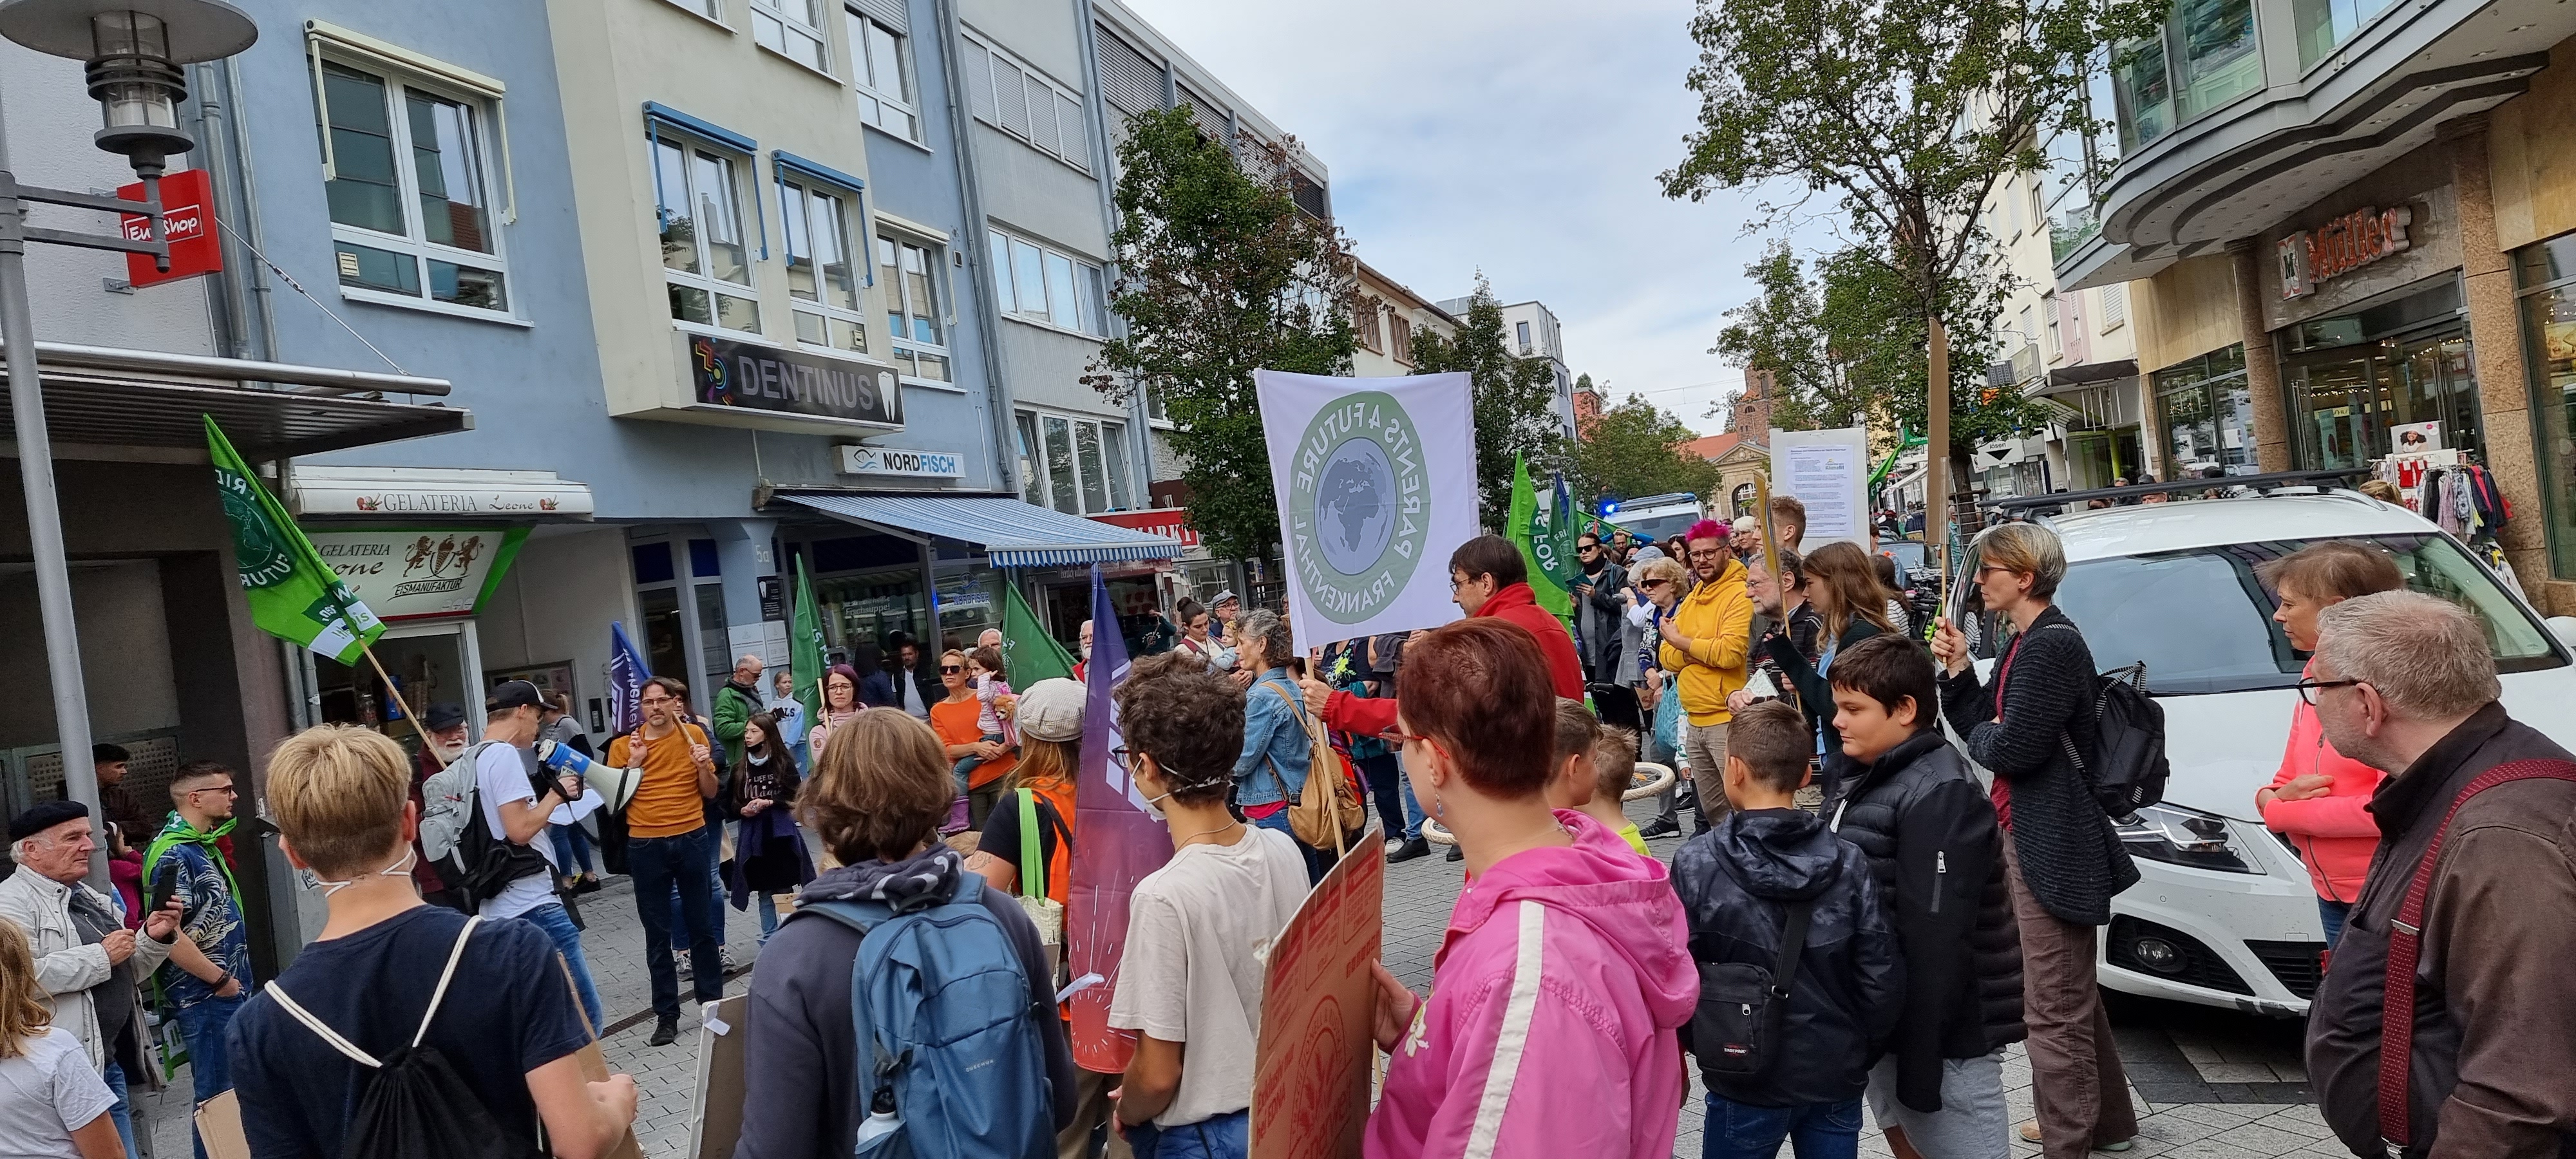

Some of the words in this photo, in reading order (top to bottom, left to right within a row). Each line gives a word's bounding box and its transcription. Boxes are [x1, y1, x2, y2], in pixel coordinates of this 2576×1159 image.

[2305, 207, 2398, 284] Müller
[737, 355, 875, 411] DENTINUS
[883, 451, 957, 473] NORDFISCH
[383, 493, 478, 512] GELATERIA
[488, 494, 535, 511] Leone
[320, 544, 390, 557] GELATERIA
[755, 544, 770, 563] 5a
[394, 578, 462, 596] EISMANUFAKTUR
